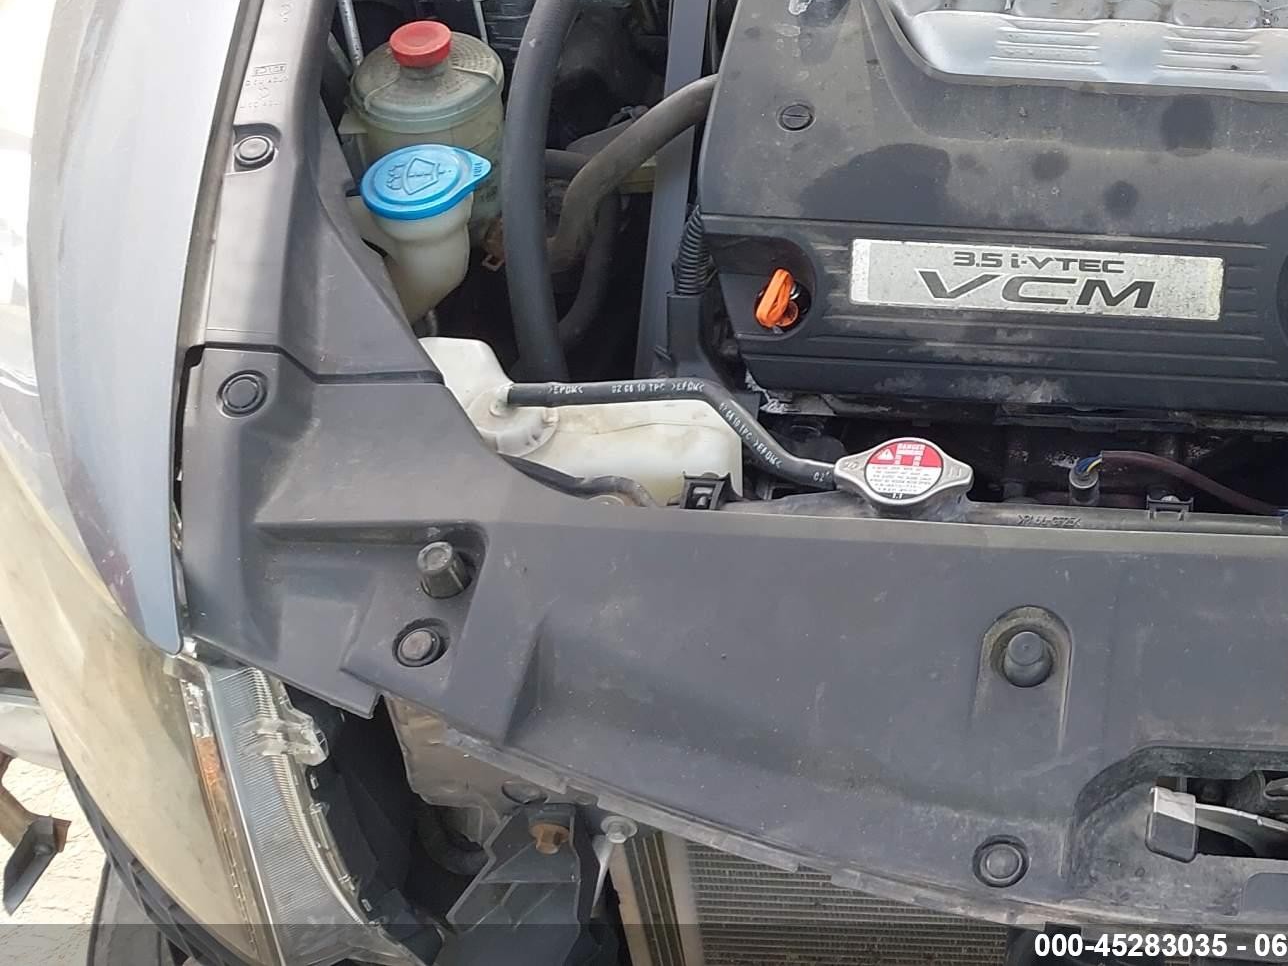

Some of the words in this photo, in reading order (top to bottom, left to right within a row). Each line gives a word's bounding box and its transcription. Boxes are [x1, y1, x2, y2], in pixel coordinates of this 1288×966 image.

[953, 251, 1003, 268] 3.5
[1010, 252, 1126, 274] i-VTEC
[917, 269, 1156, 309] VCM
